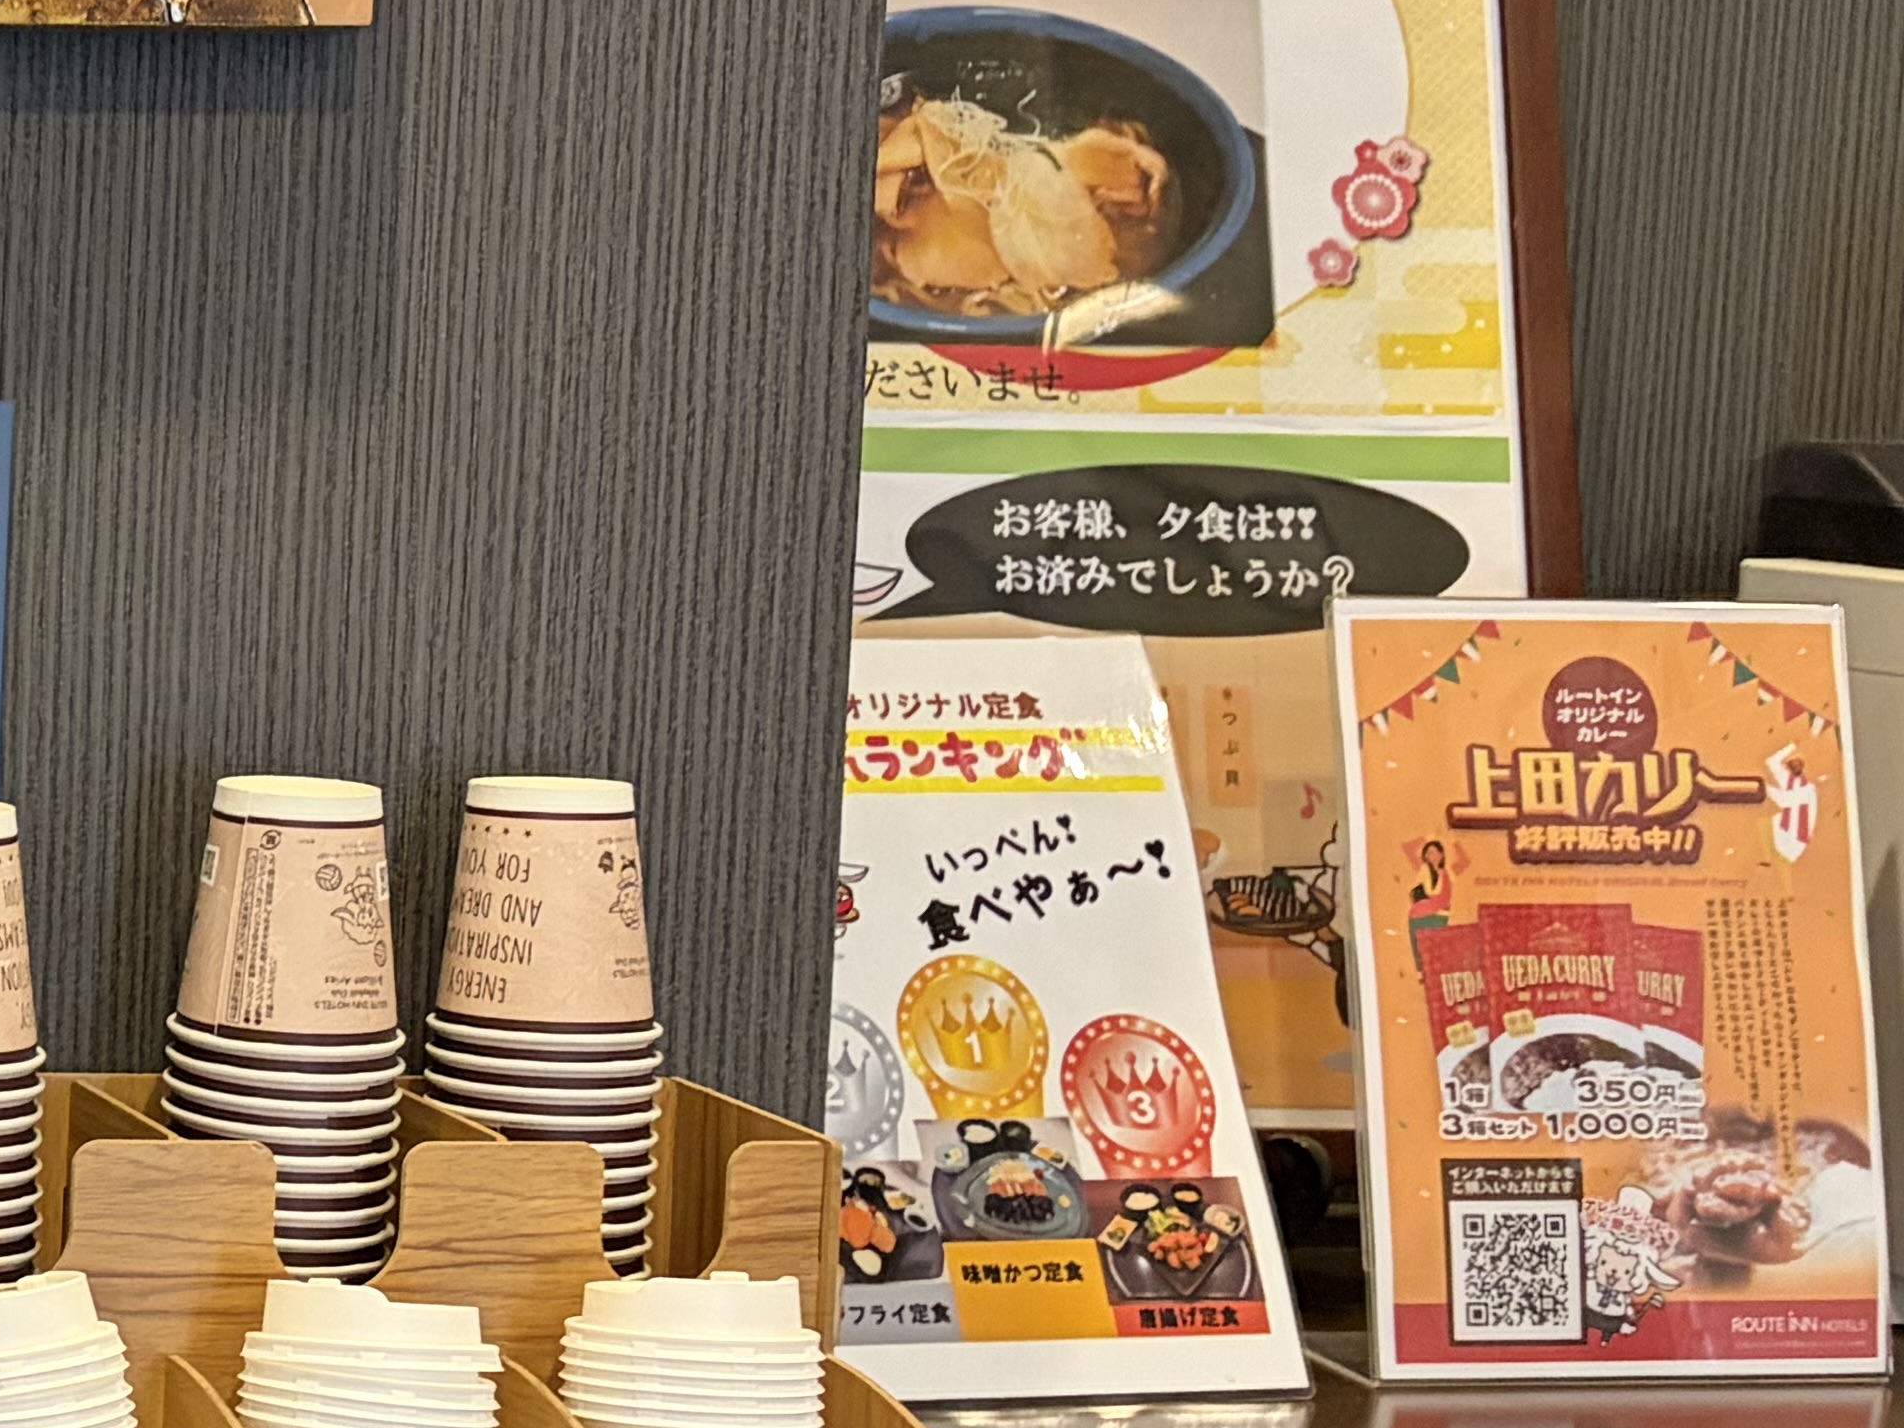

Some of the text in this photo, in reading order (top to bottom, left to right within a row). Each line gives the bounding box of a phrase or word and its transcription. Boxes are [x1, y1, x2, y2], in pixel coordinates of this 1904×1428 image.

[1555, 687, 1643, 705] ルートイン
[1556, 706, 1645, 724] オリジナル
[1576, 726, 1628, 743] カレー
[1448, 745, 1763, 822] 上田カリー
[496, 853, 531, 884] FOR
[500, 894, 543, 927] AND
[446, 966, 507, 1004] ENERGY
[1637, 970, 1686, 1008] URRY
[964, 1031, 983, 1064] 1
[1128, 1090, 1157, 1125] 3
[840, 1301, 953, 1327] フライ定食
